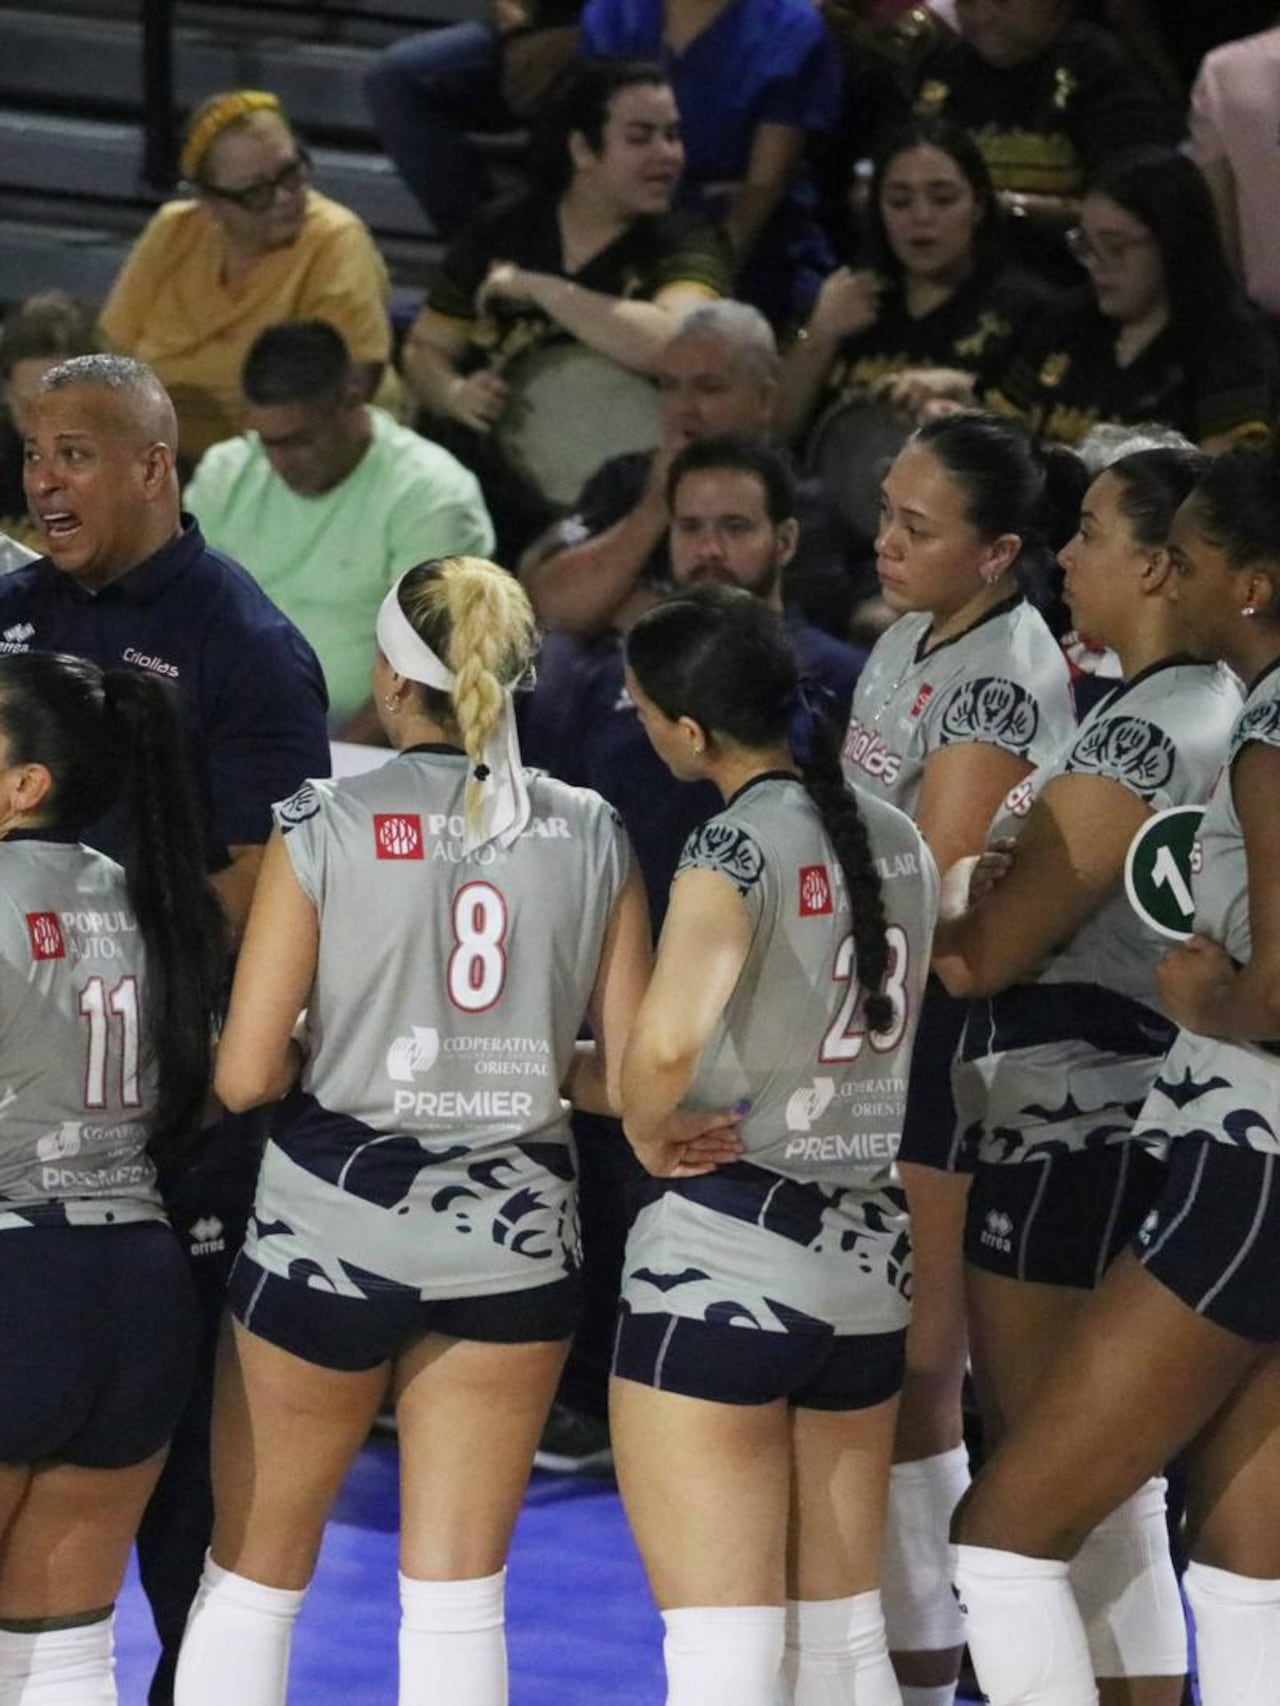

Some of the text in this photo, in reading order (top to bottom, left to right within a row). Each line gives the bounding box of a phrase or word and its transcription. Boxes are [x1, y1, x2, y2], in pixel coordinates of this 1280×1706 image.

[122, 646, 180, 678] Criollas
[428, 813, 572, 839] POAR
[431, 840, 496, 866] AUO
[61, 910, 137, 933] POPUL
[446, 880, 509, 1013] 8
[818, 922, 910, 1065] 23
[78, 975, 142, 1109] 11
[443, 1036, 551, 1054] COOPERATIVA
[474, 1060, 549, 1077] ORIENTAL
[392, 1089, 533, 1117] PREMIER
